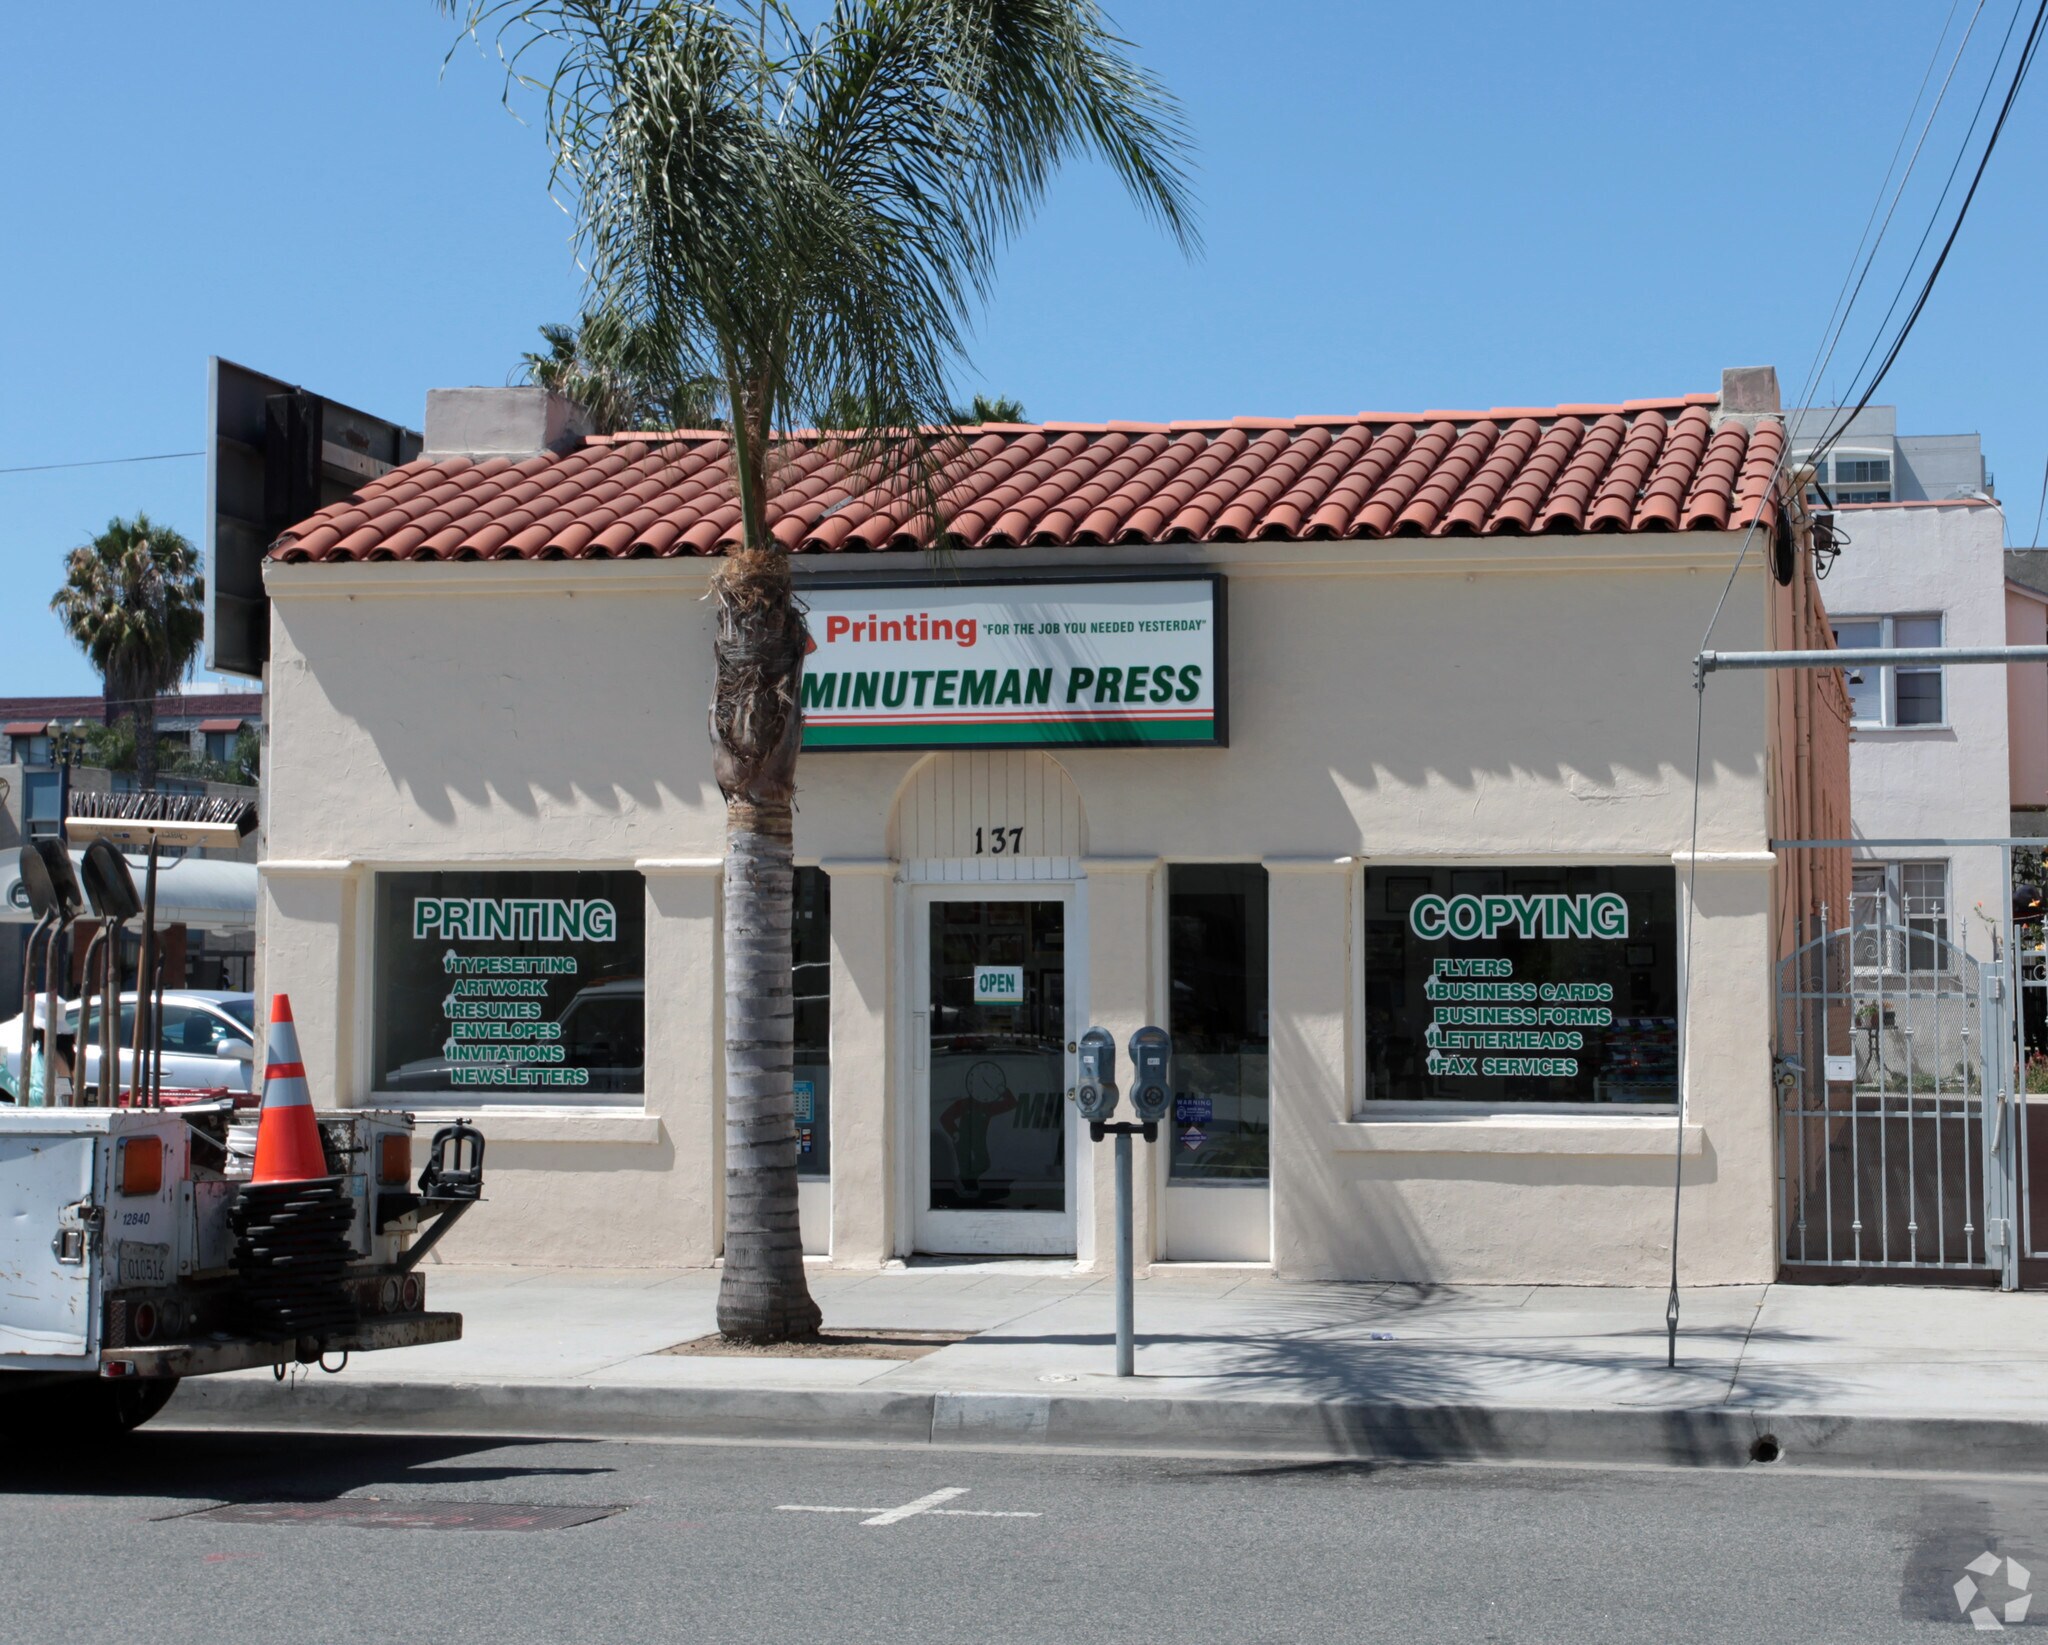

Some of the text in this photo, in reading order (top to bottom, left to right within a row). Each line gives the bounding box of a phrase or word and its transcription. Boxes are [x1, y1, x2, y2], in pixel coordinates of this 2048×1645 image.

[827, 613, 977, 648] Printing
[1014, 623, 1035, 635] THE
[1037, 622, 1060, 635] JOB
[1064, 621, 1086, 634] YOU
[1090, 621, 1135, 634] NEEDED
[801, 664, 1202, 709] MINUTEMAN PRESS
[975, 826, 1024, 855] 137
[413, 897, 617, 942] PRINTING
[1409, 892, 1629, 941] COPYING
[452, 956, 577, 974] TYPESETTING
[1433, 958, 1513, 977] FLYERS
[452, 979, 548, 996] ARTWORK
[979, 972, 1015, 993] OPEN
[1434, 982, 1613, 1002] BUSINESS CARDS
[452, 1001, 541, 1019] RESUMES
[1434, 1007, 1612, 1026] BUSINESS FORMS
[451, 1022, 561, 1039] ENVELOPES
[1434, 1031, 1583, 1050] LETTERHEADS
[452, 1044, 565, 1062] INVITATIONS
[451, 1067, 589, 1085] NEWSLETTERS
[1435, 1057, 1578, 1076] FAX SERVICES
[123, 1212, 150, 1226] 12840
